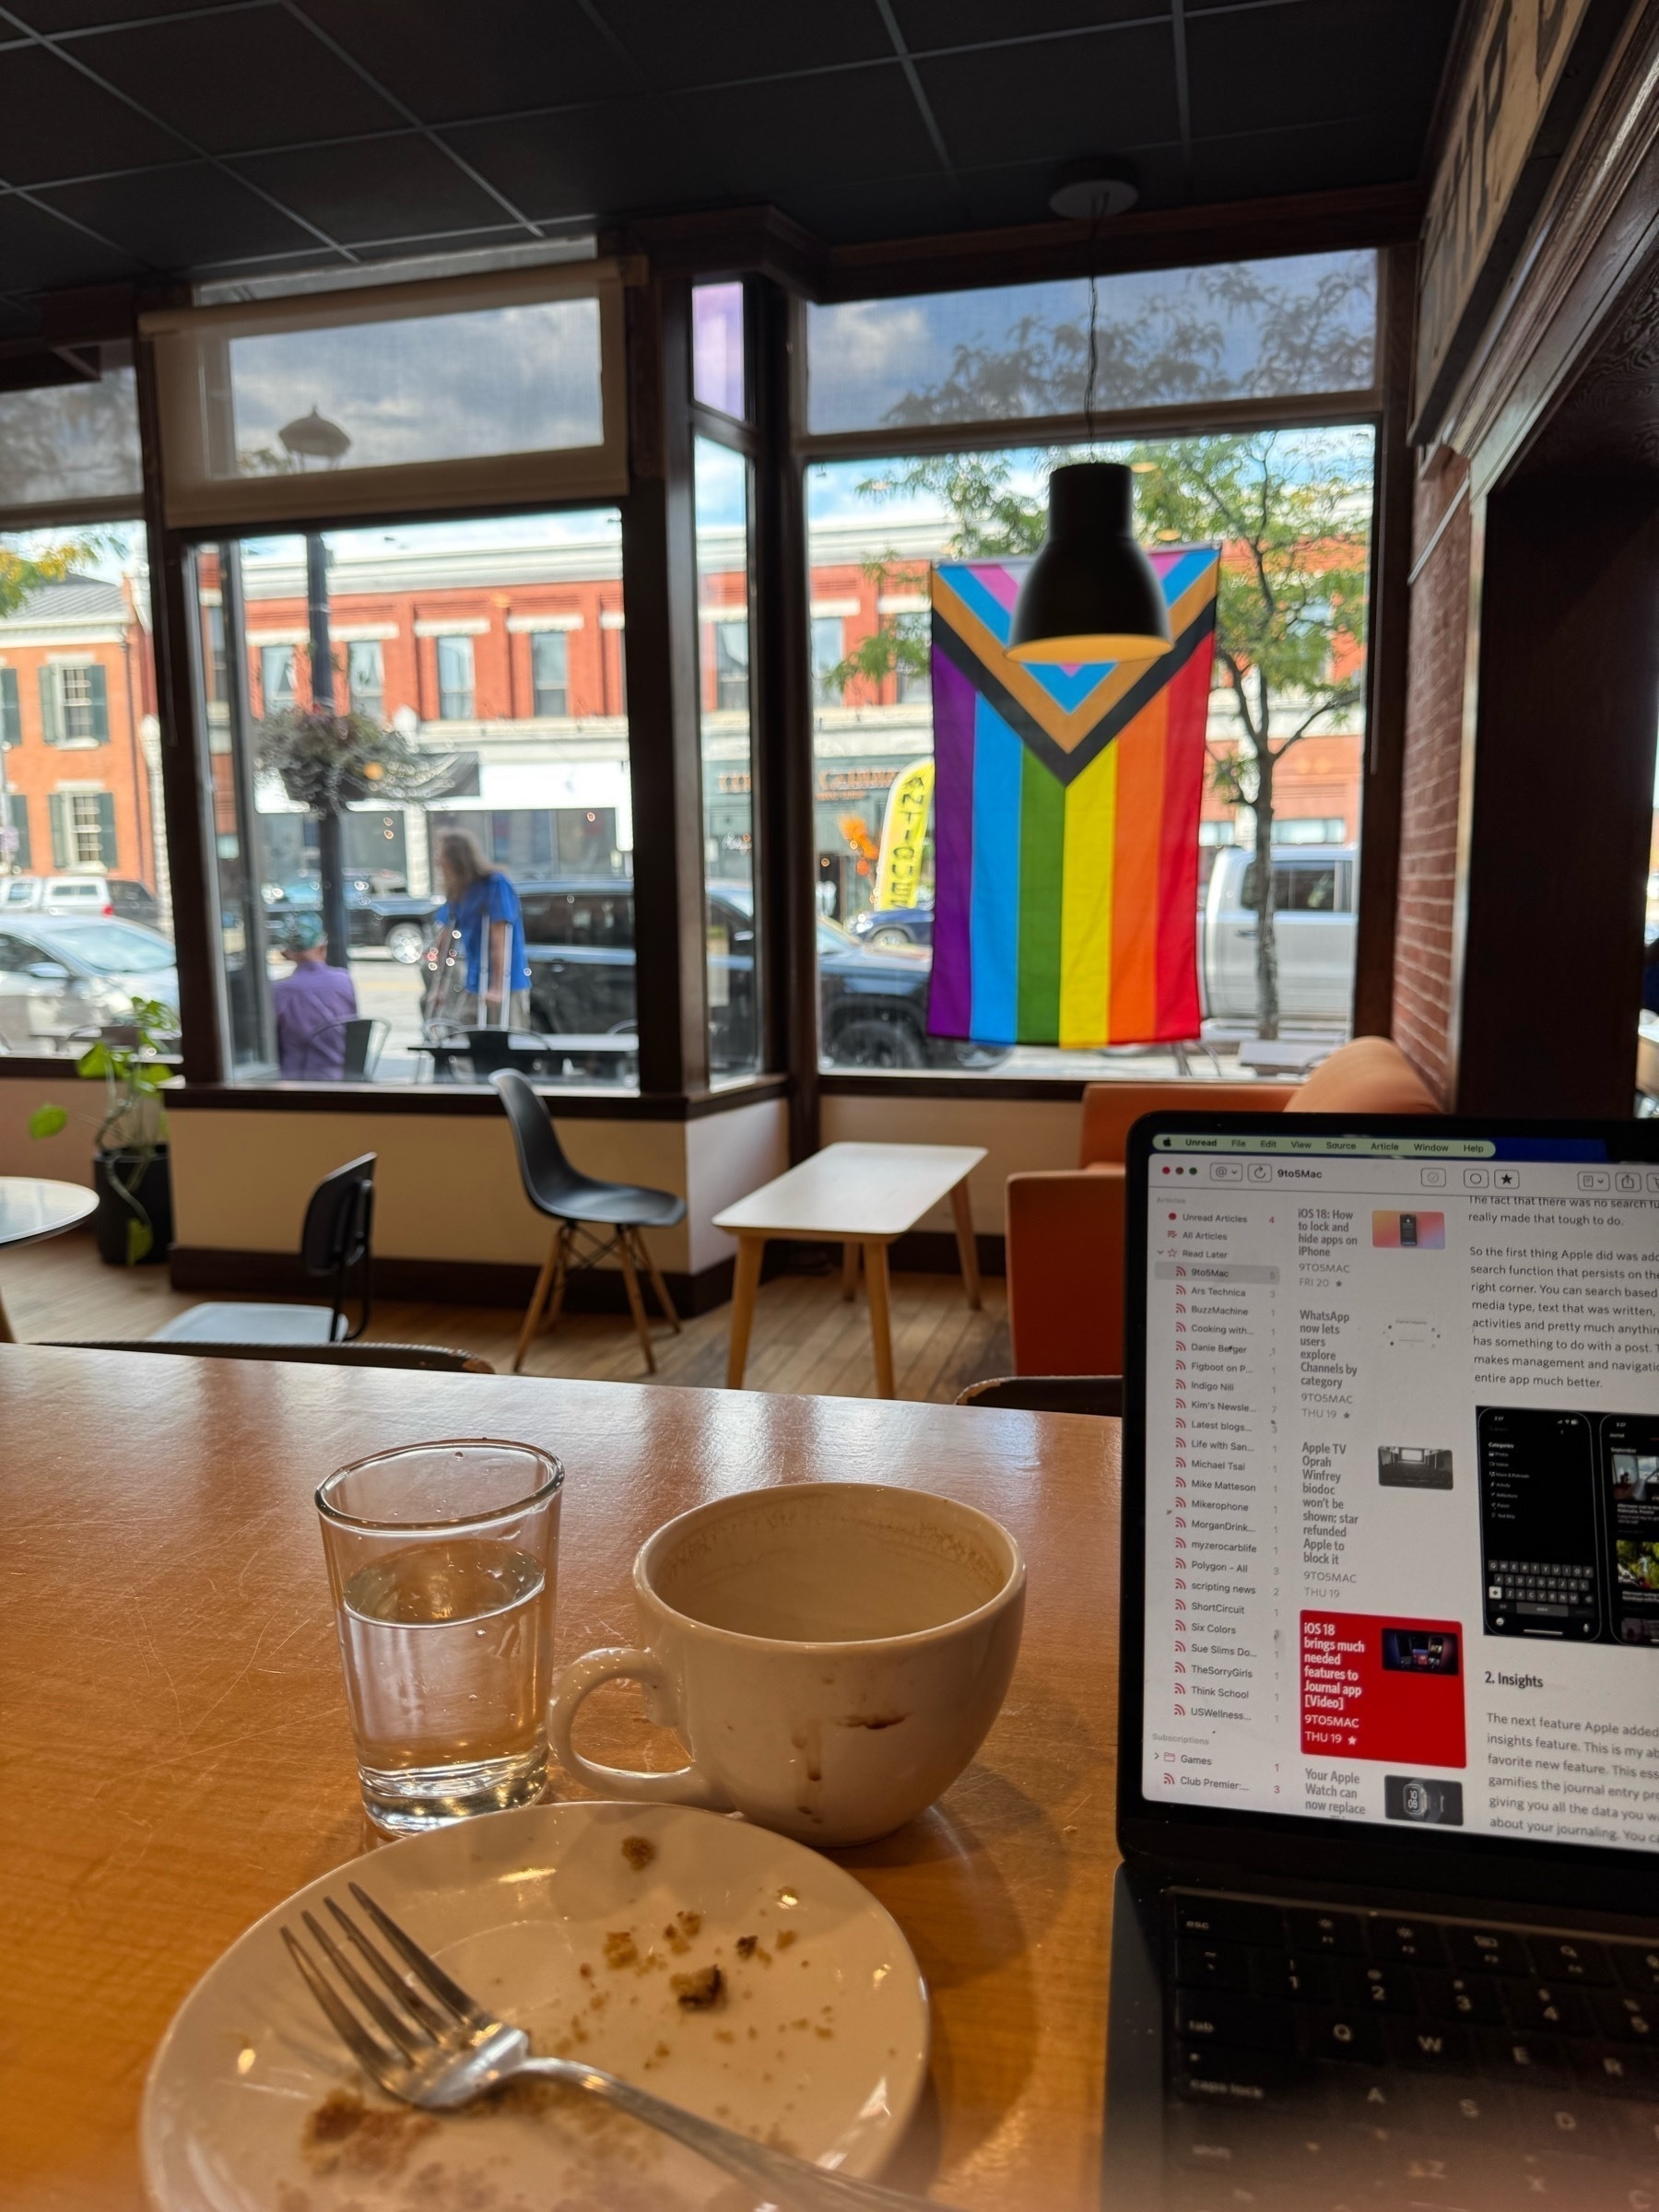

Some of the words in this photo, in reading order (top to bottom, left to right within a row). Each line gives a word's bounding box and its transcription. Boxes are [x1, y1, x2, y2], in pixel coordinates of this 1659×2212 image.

[1185, 1138, 1218, 1147] Unread
[1290, 1140, 1312, 1148] View
[1325, 1141, 1356, 1149] Source
[1371, 1142, 1399, 1150] Article
[1413, 1143, 1449, 1151] Window
[1463, 1144, 1484, 1153] Help
[1277, 1169, 1322, 1178] 9to5Mac
[1298, 1207, 1314, 1218] iOS
[1315, 1208, 1330, 1218] 18:
[1332, 1209, 1353, 1219] How
[1468, 1212, 1498, 1223] really
[1500, 1213, 1530, 1222] made
[1534, 1213, 1555, 1223] that
[1558, 1214, 1590, 1226] tough
[1592, 1216, 1604, 1225] to
[1606, 1216, 1624, 1226] do.
[1298, 1221, 1308, 1230] to
[1310, 1220, 1329, 1231] lock
[1331, 1221, 1349, 1232] and
[1194, 1231, 1228, 1241] Articles
[1298, 1232, 1318, 1243] hide
[1320, 1236, 1343, 1246] apps
[1345, 1237, 1358, 1245] on
[1182, 1249, 1204, 1257] Read
[1298, 1246, 1331, 1257] iPhone
[1469, 1246, 1483, 1255] So
[1486, 1246, 1503, 1256] the
[1506, 1246, 1527, 1257] first
[1530, 1248, 1559, 1260] thing
[1560, 1250, 1593, 1261] Apple
[1595, 1250, 1613, 1260] did
[1616, 1253, 1639, 1261] was
[1191, 1268, 1229, 1277] 9to5Mac
[1470, 1265, 1506, 1274] search
[1509, 1265, 1553, 1276] function
[1557, 1266, 1578, 1277] that
[1582, 1268, 1625, 1278] persists
[1628, 1271, 1641, 1279] on
[1191, 1287, 1206, 1295] Ars
[1207, 1287, 1246, 1297] Technica
[1471, 1282, 1496, 1293] right
[1499, 1285, 1536, 1293] corner.
[1539, 1284, 1559, 1294] You
[1562, 1287, 1582, 1295] can
[1584, 1287, 1621, 1296] search
[1624, 1287, 1658, 1298] based
[1191, 1305, 1248, 1315] BuzzMachine
[1471, 1300, 1505, 1310] media
[1508, 1301, 1535, 1312] type,
[1537, 1302, 1559, 1312] text
[1561, 1303, 1584, 1313] that
[1587, 1306, 1609, 1314] was
[1612, 1305, 1655, 1317] written,
[1299, 1309, 1349, 1324] WhatsApp
[1300, 1324, 1320, 1333] now
[1322, 1323, 1340, 1335] lets
[1472, 1318, 1521, 1329] activities
[1524, 1320, 1545, 1330] and
[1547, 1322, 1581, 1333] pretty
[1583, 1323, 1615, 1333] much
[1300, 1337, 1325, 1347] users
[1473, 1335, 1492, 1346] has
[1495, 1337, 1553, 1350] something
[1556, 1339, 1567, 1348] to
[1570, 1339, 1584, 1349] do
[1587, 1341, 1612, 1351] with
[1624, 1343, 1652, 1353] post.
[1300, 1348, 1335, 1361] explore
[1300, 1361, 1344, 1373] Channels
[1345, 1363, 1357, 1377] by
[1474, 1354, 1509, 1365] makes
[1512, 1358, 1584, 1369] management
[1587, 1359, 1608, 1370] and
[1300, 1375, 1343, 1389] category
[1474, 1373, 1506, 1382] entire
[1509, 1376, 1529, 1385] app
[1533, 1375, 1563, 1385] much
[1566, 1376, 1603, 1387] better.
[1301, 1441, 1330, 1454] Apple
[1332, 1443, 1347, 1454] TV
[1191, 1459, 1225, 1469] Michael
[1227, 1462, 1245, 1470] Tsai
[1301, 1454, 1331, 1468] Oprah
[1302, 1469, 1341, 1484] Winfrey
[1191, 1479, 1212, 1488] Mike
[1214, 1481, 1255, 1491] Matteson
[1302, 1482, 1335, 1495] biodoc
[1191, 1500, 1249, 1512] Mikerophone
[1332, 1498, 1344, 1509] be
[1302, 1510, 1336, 1524] shown;
[1338, 1513, 1359, 1524] star
[1302, 1524, 1347, 1536] refunded
[1191, 1541, 1257, 1553] myzerocarblife
[1302, 1537, 1332, 1551] Apple
[1334, 1540, 1345, 1551] to
[1303, 1551, 1329, 1563] block
[1331, 1553, 1339, 1564] it
[1191, 1582, 1230, 1594] scripting
[1232, 1586, 1256, 1594] news
[1191, 1601, 1244, 1614] ShortCircuit
[1304, 1622, 1322, 1635] iOS
[1323, 1624, 1335, 1636] 18
[1303, 1636, 1335, 1653] brings
[1336, 1641, 1365, 1653] much
[1304, 1653, 1341, 1665] needed
[1191, 1665, 1253, 1677] TheSorryGirls
[1304, 1665, 1346, 1680] features
[1347, 1669, 1359, 1681] to
[1485, 1670, 1495, 1683] 2.
[1498, 1672, 1544, 1688] Insights
[1191, 1686, 1216, 1696] Think
[1218, 1688, 1249, 1699] School
[1304, 1679, 1341, 1694] Journal
[1342, 1686, 1362, 1699] app
[1304, 1694, 1344, 1711] [Video]
[1180, 1754, 1212, 1765] Games
[1333, 2024, 1352, 2042] Q
[1418, 2035, 1442, 2053] W
[1512, 2046, 1531, 2065] E
[1367, 2087, 1386, 2103] A
[1460, 2099, 1479, 2117] S
